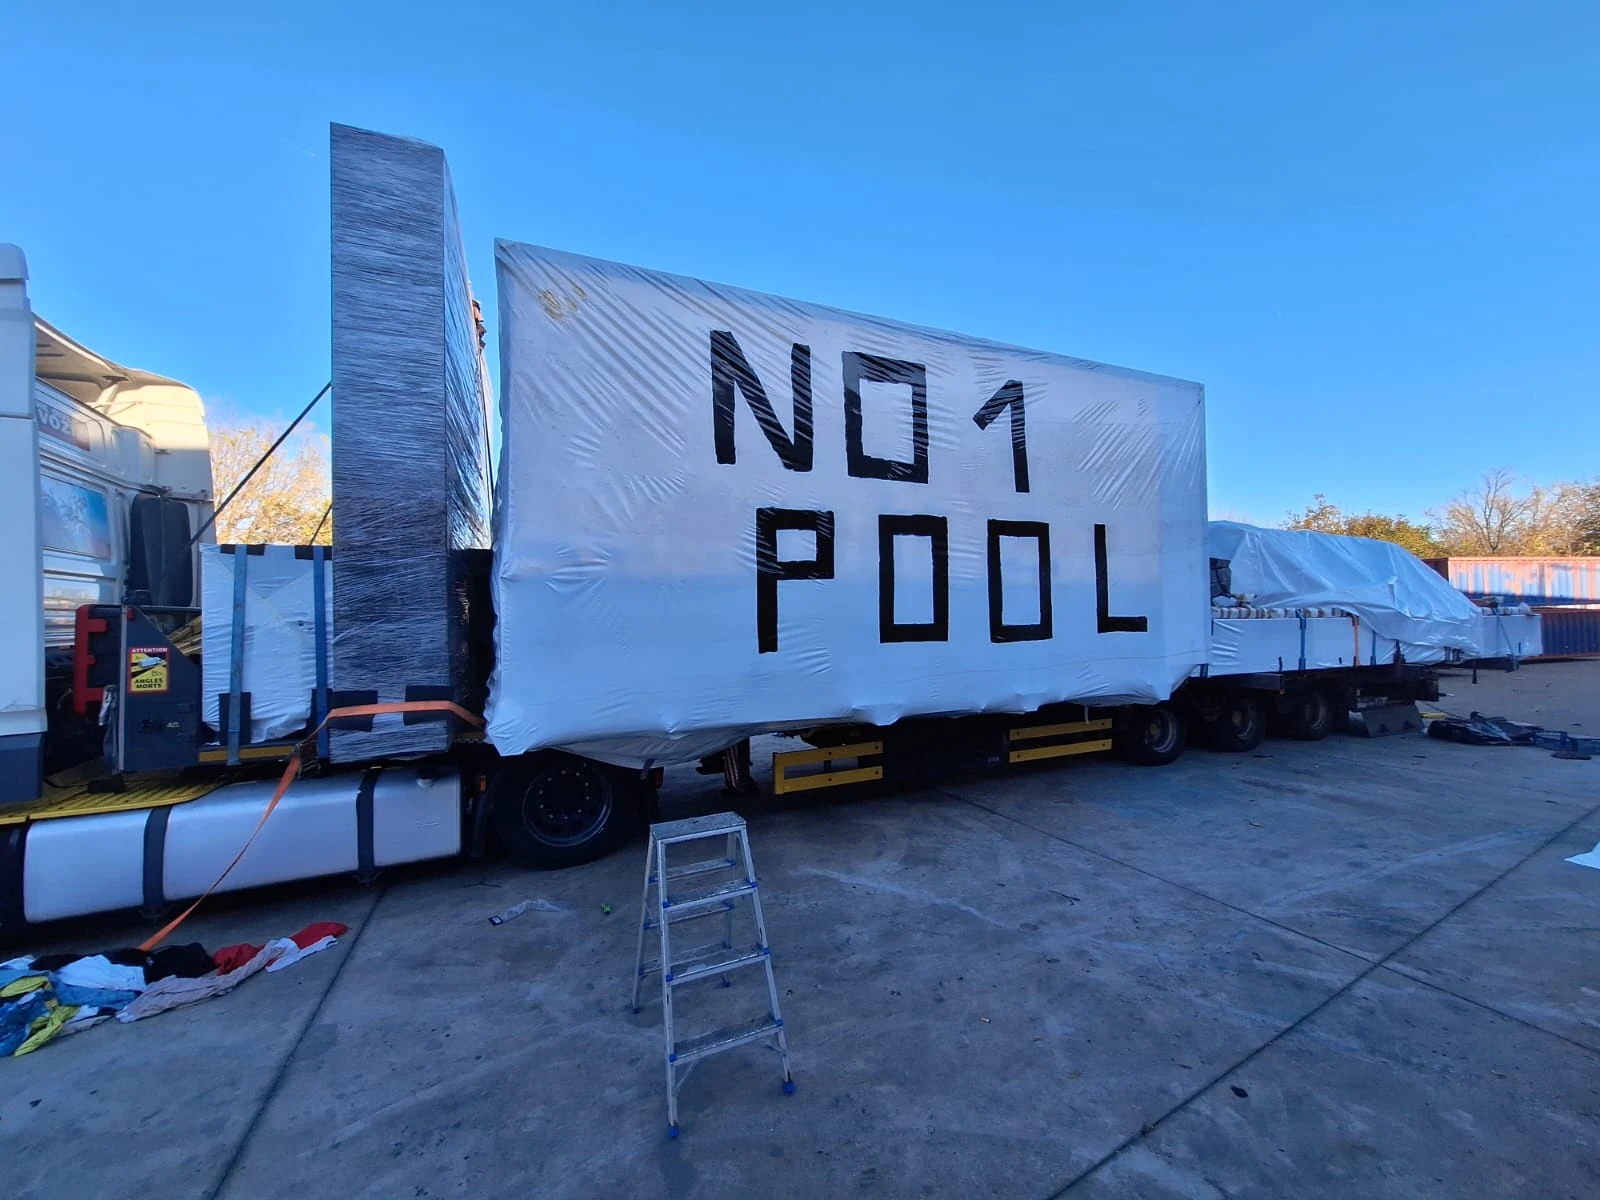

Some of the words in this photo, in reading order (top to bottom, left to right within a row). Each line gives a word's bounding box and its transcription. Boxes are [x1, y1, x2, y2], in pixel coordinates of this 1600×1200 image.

[710, 330, 929, 484] NO
[972, 380, 1030, 493] 1
[756, 508, 1148, 654] POOL
